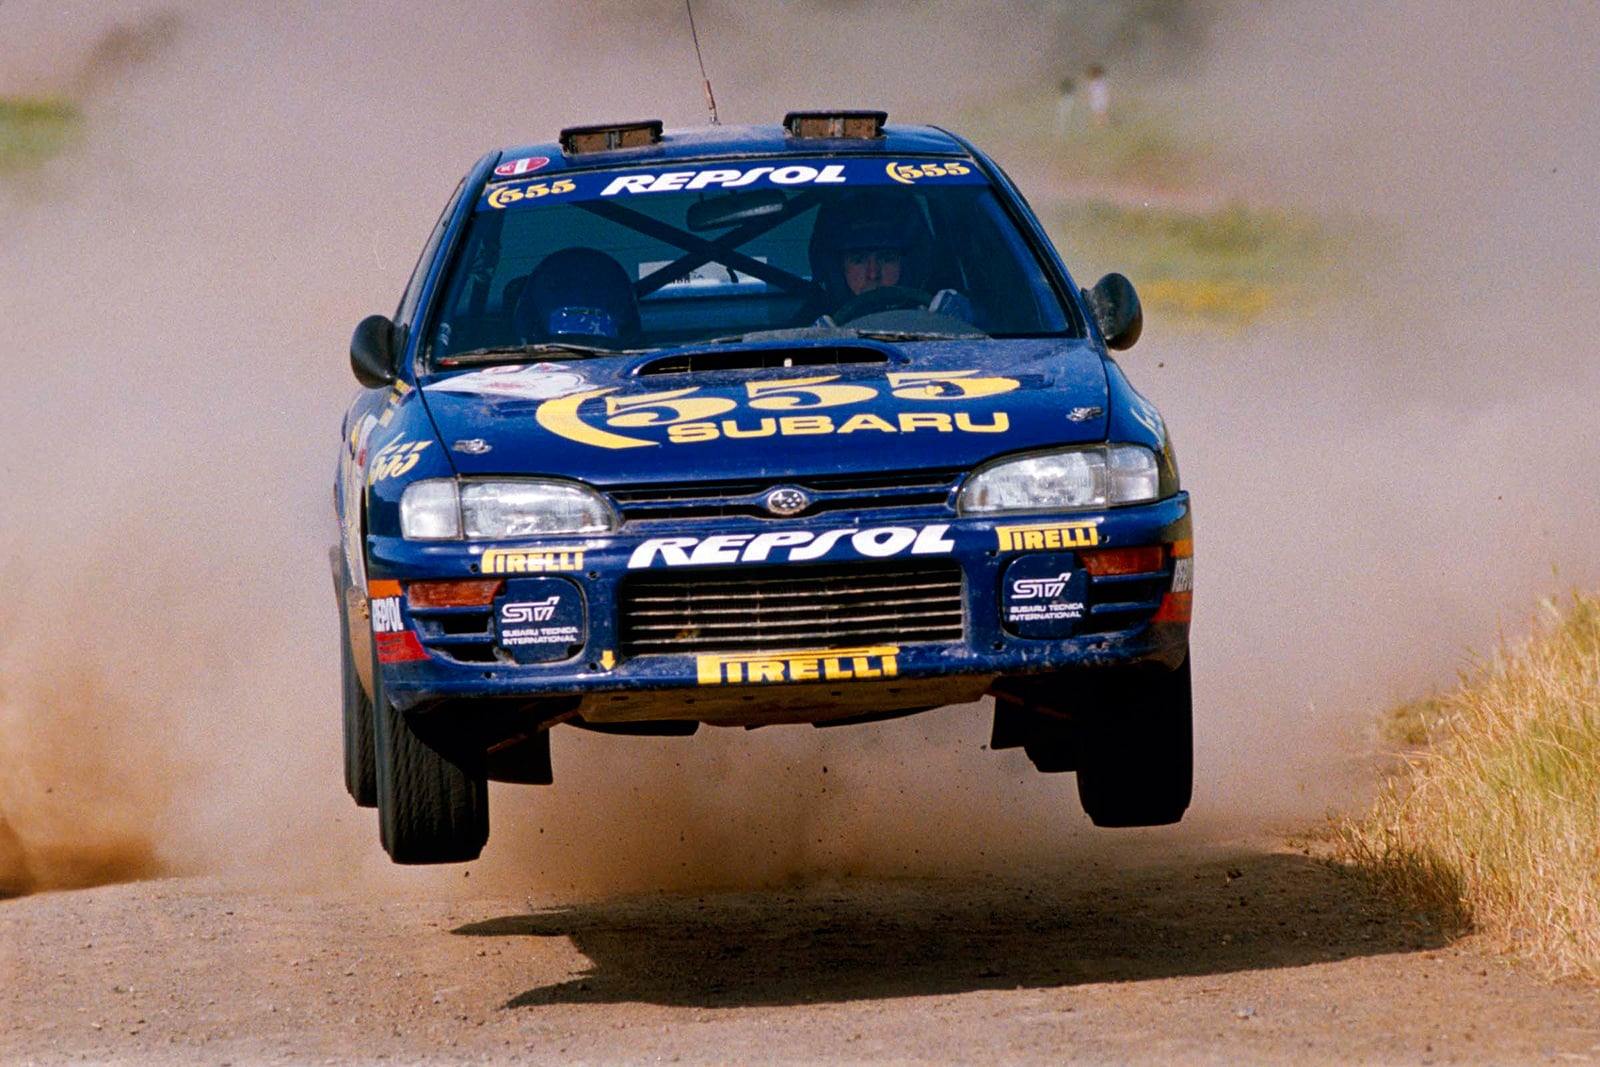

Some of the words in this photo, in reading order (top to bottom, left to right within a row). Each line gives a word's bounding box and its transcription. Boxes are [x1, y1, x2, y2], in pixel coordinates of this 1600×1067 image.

[600, 164, 847, 196] REPSOL
[896, 162, 971, 180] 555
[497, 178, 577, 204] 555
[605, 369, 1021, 428] 555
[668, 412, 1010, 444] SUBARU
[627, 524, 956, 569] REPSOL
[995, 521, 1099, 551] PIRELLI
[481, 547, 588, 574] PIRELLI
[1009, 611, 1082, 622] INTERNATIONAL
[1010, 604, 1047, 613] SUBARU
[1048, 602, 1084, 612] TECNICA
[502, 628, 539, 637] SUBARU
[540, 626, 579, 635] TECNICA
[502, 635, 577, 645] INTERNATIONAL
[697, 645, 900, 685] PIRELLI
